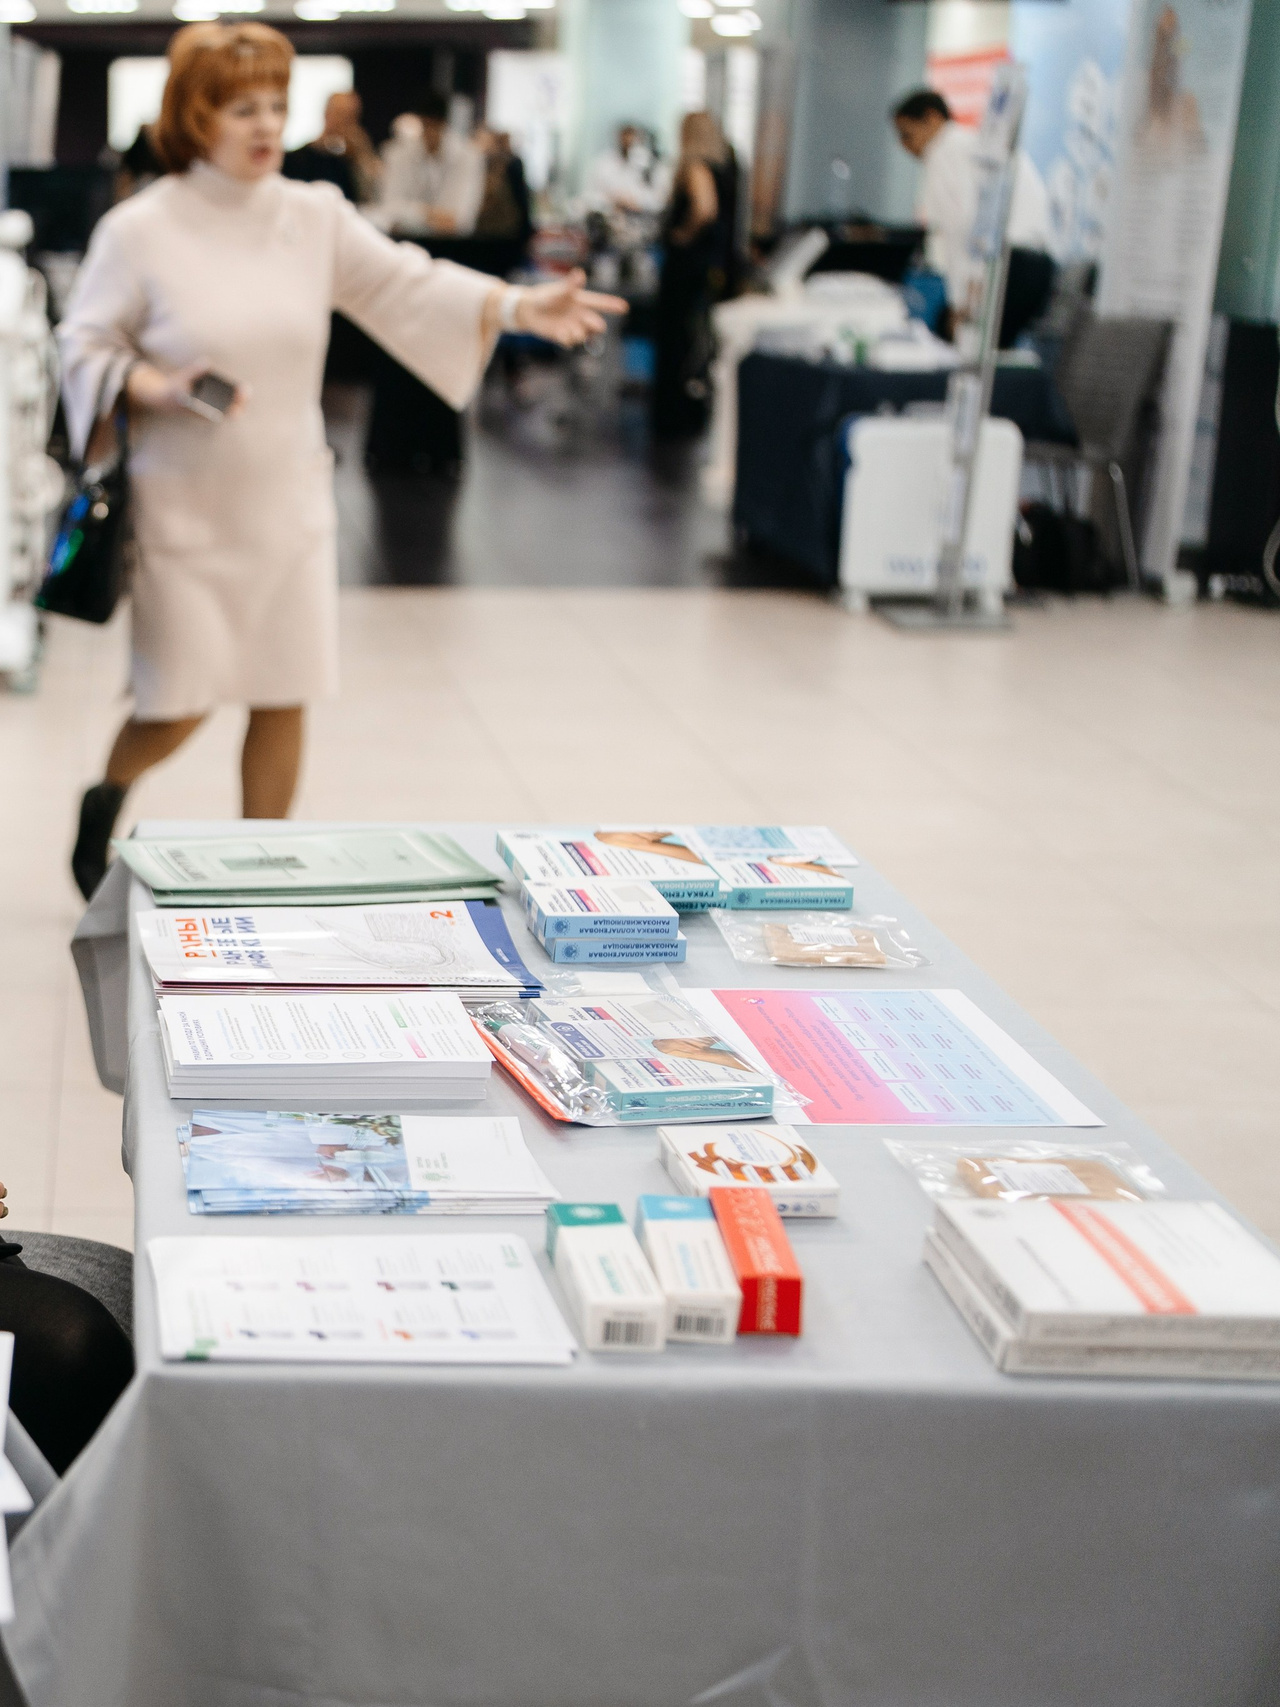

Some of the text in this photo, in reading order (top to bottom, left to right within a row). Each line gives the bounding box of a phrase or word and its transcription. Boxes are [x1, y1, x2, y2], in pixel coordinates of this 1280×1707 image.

[690, 890, 714, 898] ГУБКА
[429, 909, 455, 921] 2
[593, 919, 671, 927] РАНОЗАЖИВЛЯЮЩАЯ
[578, 927, 670, 935] ПОВЯЗКА КОЛЛАГЕНОВАЯ
[601, 942, 679, 951] РАНОЗАЖИВЛЯЮЩАЯ
[587, 950, 679, 959] ПОВЯЗКА КОЛЛАГЕНОВАЯ
